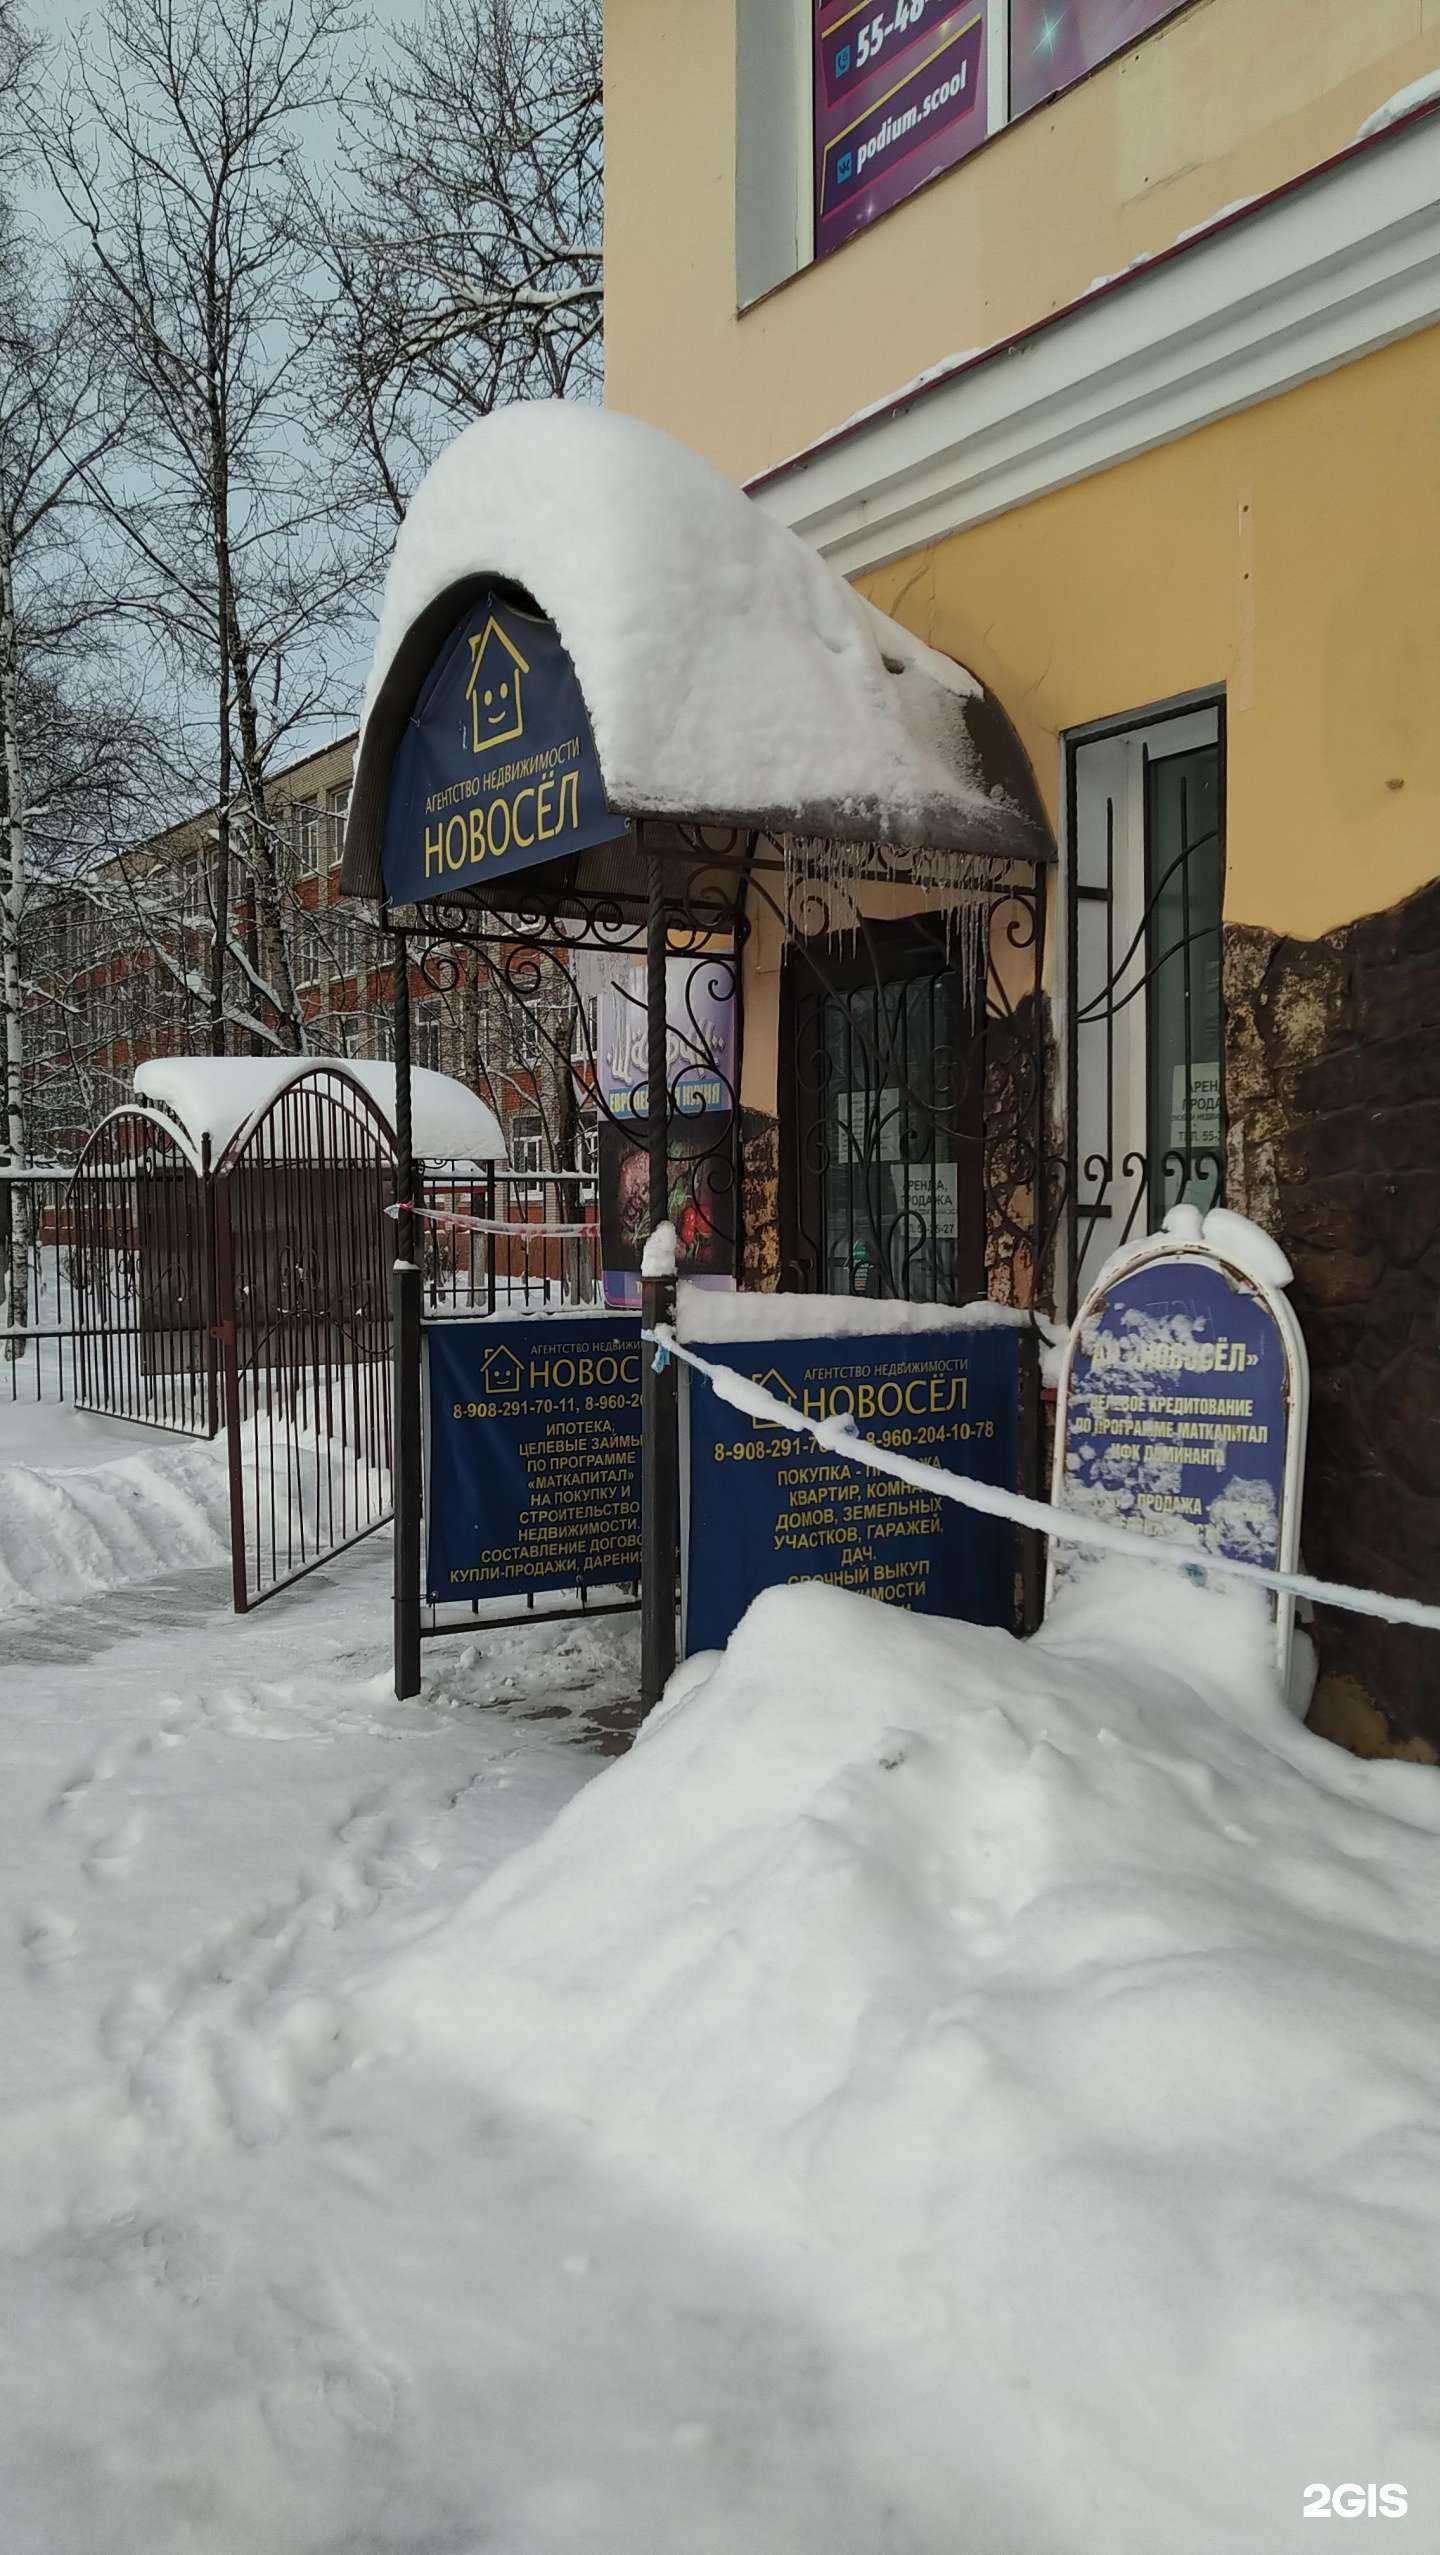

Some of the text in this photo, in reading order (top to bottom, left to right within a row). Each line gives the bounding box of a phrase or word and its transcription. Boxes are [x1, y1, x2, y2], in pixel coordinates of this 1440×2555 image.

[856, 60, 967, 175] podium.scool
[425, 736, 581, 814] АГЕНТСТВО НЕДВИЖИМОСТИ
[424, 770, 581, 878] НОВОСЁЛ
[530, 1341, 642, 1356] АГЕНТСТВО НЕДВИЖИ
[803, 1359, 969, 1382] АГЕНТСТВО НЕДВИЖИМОСТИ
[453, 1397, 580, 1419] 8-908-291-70-11,
[803, 1374, 968, 1421] НОВОСЁЛ
[1149, 1397, 1253, 1416] КРЕДИТОВАНИЕ
[546, 1420, 615, 1436] ИПОТЕКА,
[866, 1420, 994, 1449] 8-960-204-10-78
[1177, 1423, 1268, 1443] МАТКАПИТАЛ
[519, 1438, 587, 1457] ЦЕЛЕВЫЕ
[527, 1451, 636, 1472] ПО ПРОГРАММЕ
[528, 1469, 634, 1490] «МАТКАПИТАЛ»
[777, 1462, 851, 1486] ПОКУПКА
[530, 1485, 631, 1507] НА ПОКУПКУ И
[789, 1483, 861, 1507] КВАРТИР,
[1137, 1494, 1202, 1515] ПРОДАЖА
[519, 1501, 640, 1524] СТРОИТЕЛЬСТВО
[775, 1497, 943, 1532] ДОМОВ, ЗЕМЕЛЬНЫХ
[518, 1518, 641, 1542] НЕДВИЖИМОСТИ.
[774, 1527, 862, 1550] УЧАСТКОВ,
[481, 1540, 587, 1563] СОСТАВЛЕНИЕ
[841, 1546, 877, 1567] ДАЧ.
[450, 1560, 580, 1584] КУПЛИ-ПРОДАЖИ,
[873, 1560, 930, 1581] ВЫКУП
